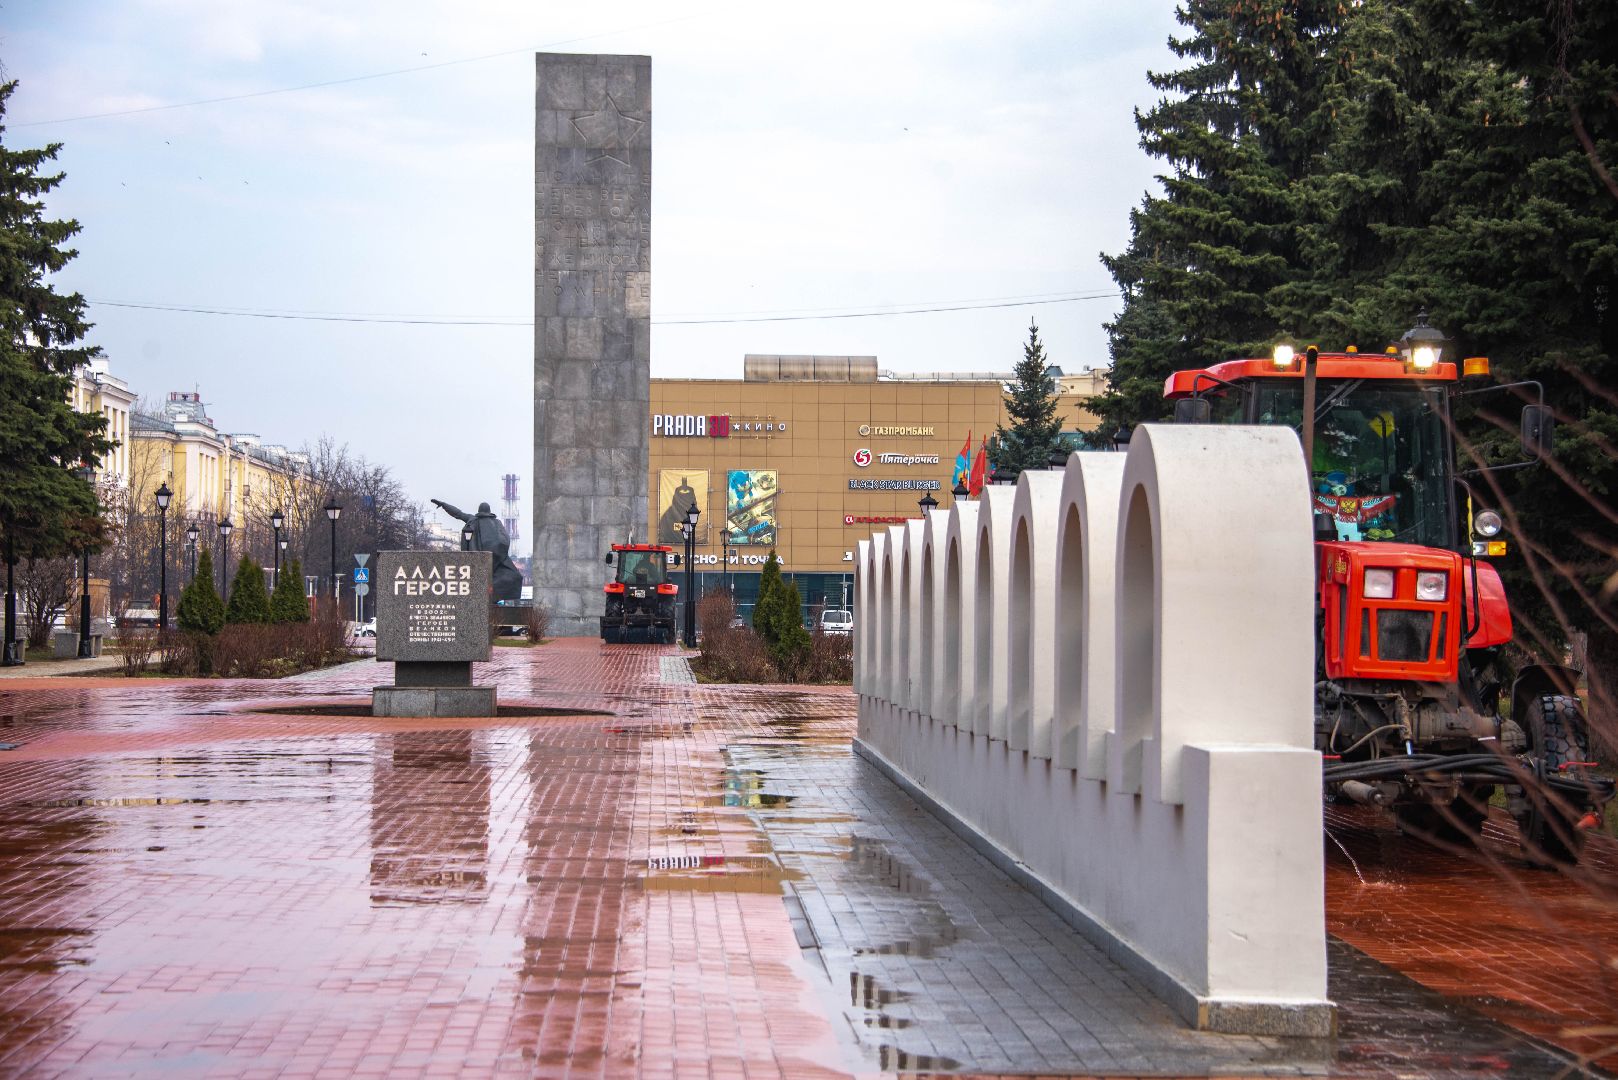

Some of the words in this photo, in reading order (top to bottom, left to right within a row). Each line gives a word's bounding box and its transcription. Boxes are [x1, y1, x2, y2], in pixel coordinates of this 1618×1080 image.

[653, 414, 706, 436] PRADA
[744, 422, 786, 431] КИНО
[874, 427, 934, 436] ГАЗПРОМБАНК
[729, 554, 739, 565] И
[395, 565, 471, 580] АЛЛЕЯ
[394, 581, 470, 596] ГЕРОЕВ
